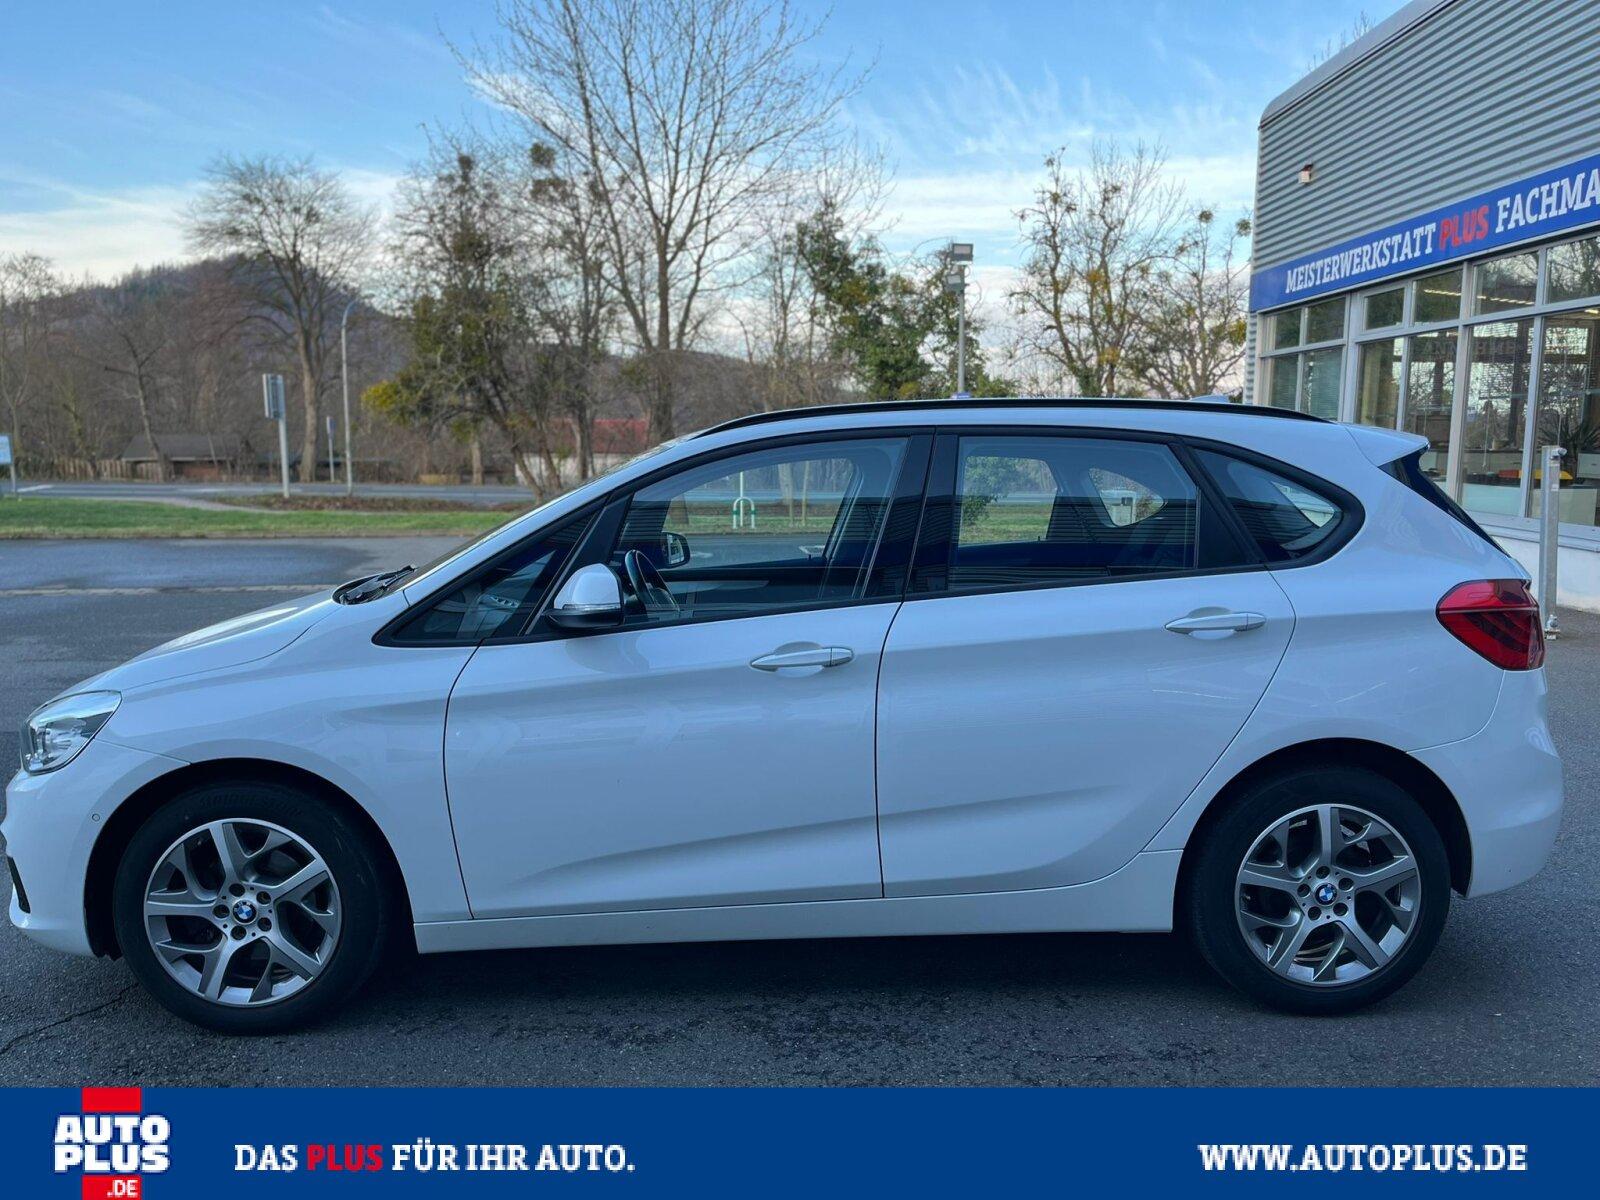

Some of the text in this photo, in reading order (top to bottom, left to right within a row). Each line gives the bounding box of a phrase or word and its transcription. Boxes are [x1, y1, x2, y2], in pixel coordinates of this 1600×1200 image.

[1285, 168, 1600, 294] MEISTERWERKSTATT PLUS FACHMA
